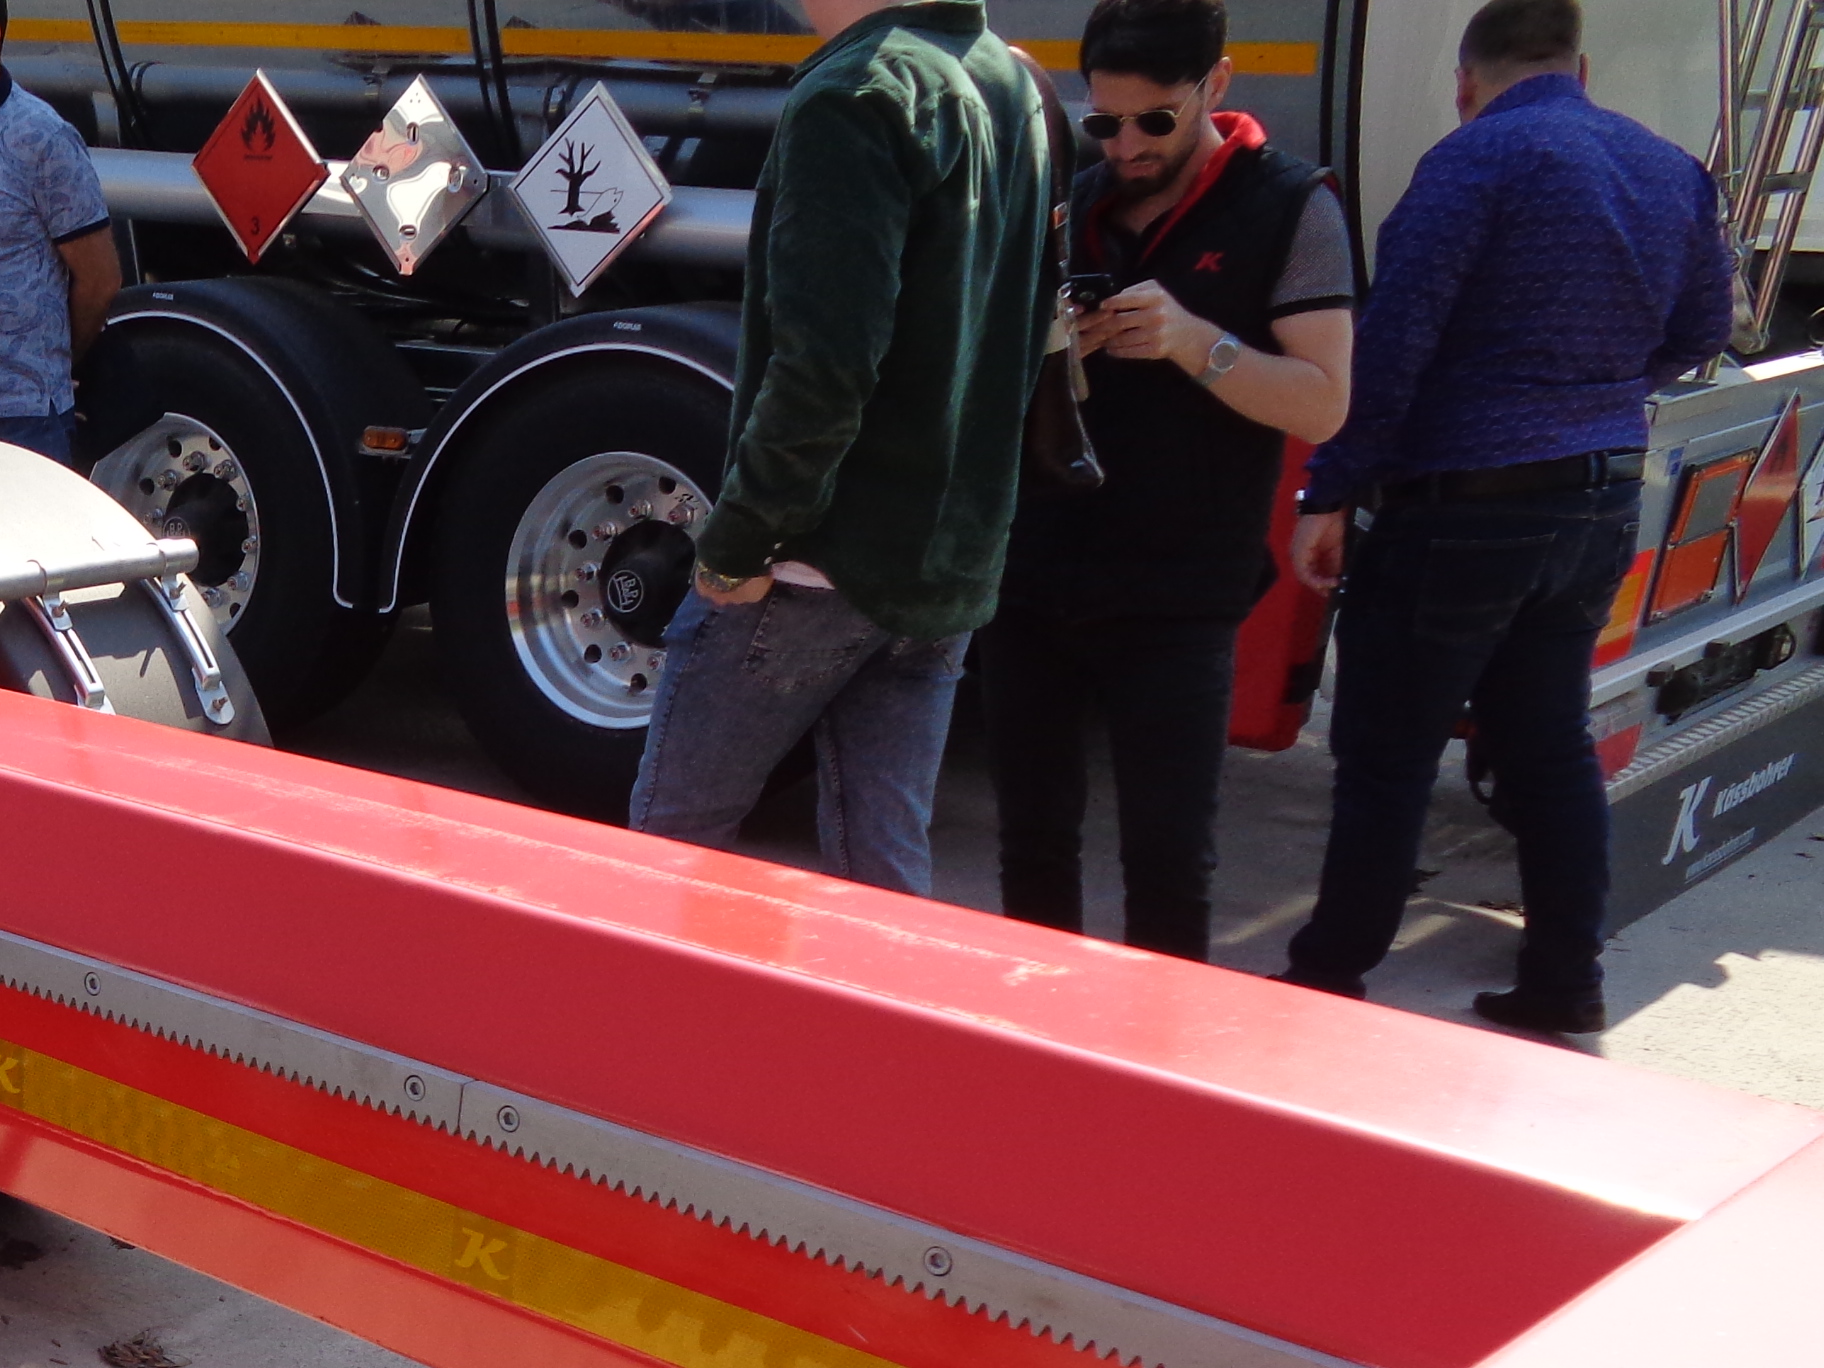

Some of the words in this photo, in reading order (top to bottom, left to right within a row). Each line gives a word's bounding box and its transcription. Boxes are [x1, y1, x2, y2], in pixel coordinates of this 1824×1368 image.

[250, 217, 260, 235] 3
[1662, 775, 1713, 866] K
[454, 1227, 510, 1281] K
